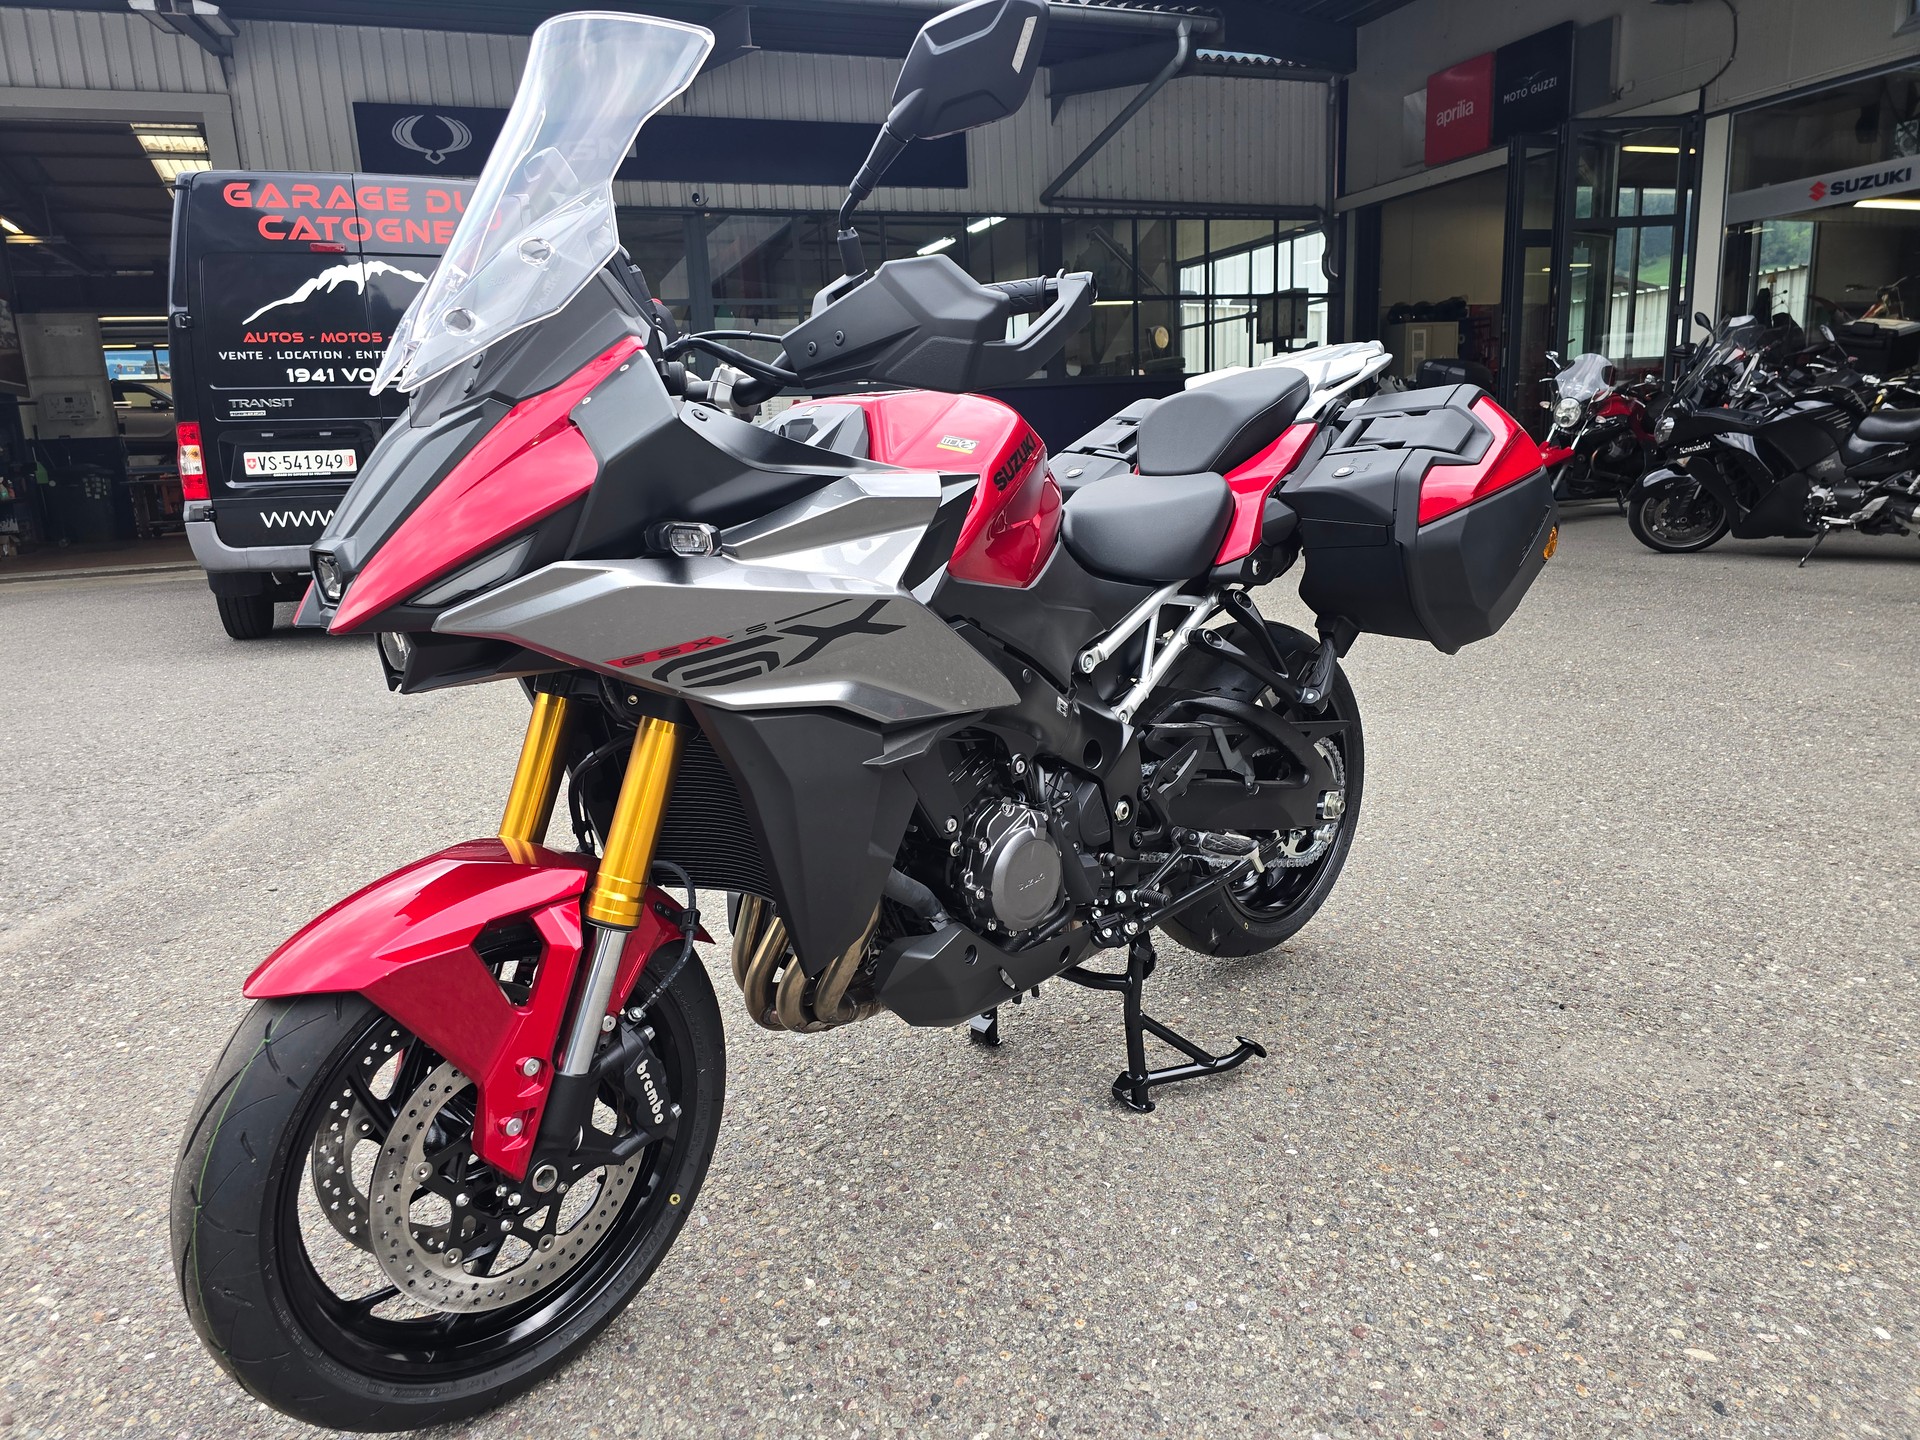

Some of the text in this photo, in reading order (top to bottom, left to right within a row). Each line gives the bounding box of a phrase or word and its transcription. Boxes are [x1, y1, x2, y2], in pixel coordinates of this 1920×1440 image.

[1503, 77, 1558, 104] MOTO GUZZI
[1436, 99, 1474, 127] aprilia
[1830, 167, 1912, 196] SUZUKI
[223, 183, 411, 211] GARAGE
[258, 215, 455, 244] CATOGNE
[243, 332, 383, 343] AUTOS MOTOS
[219, 351, 263, 360] VENTE
[277, 350, 343, 360] LOCATION
[286, 368, 335, 383] 1941
[228, 398, 294, 408] TRANSIT
[993, 432, 1036, 492] SUZUKI
[636, 1059, 664, 1125] brembo
